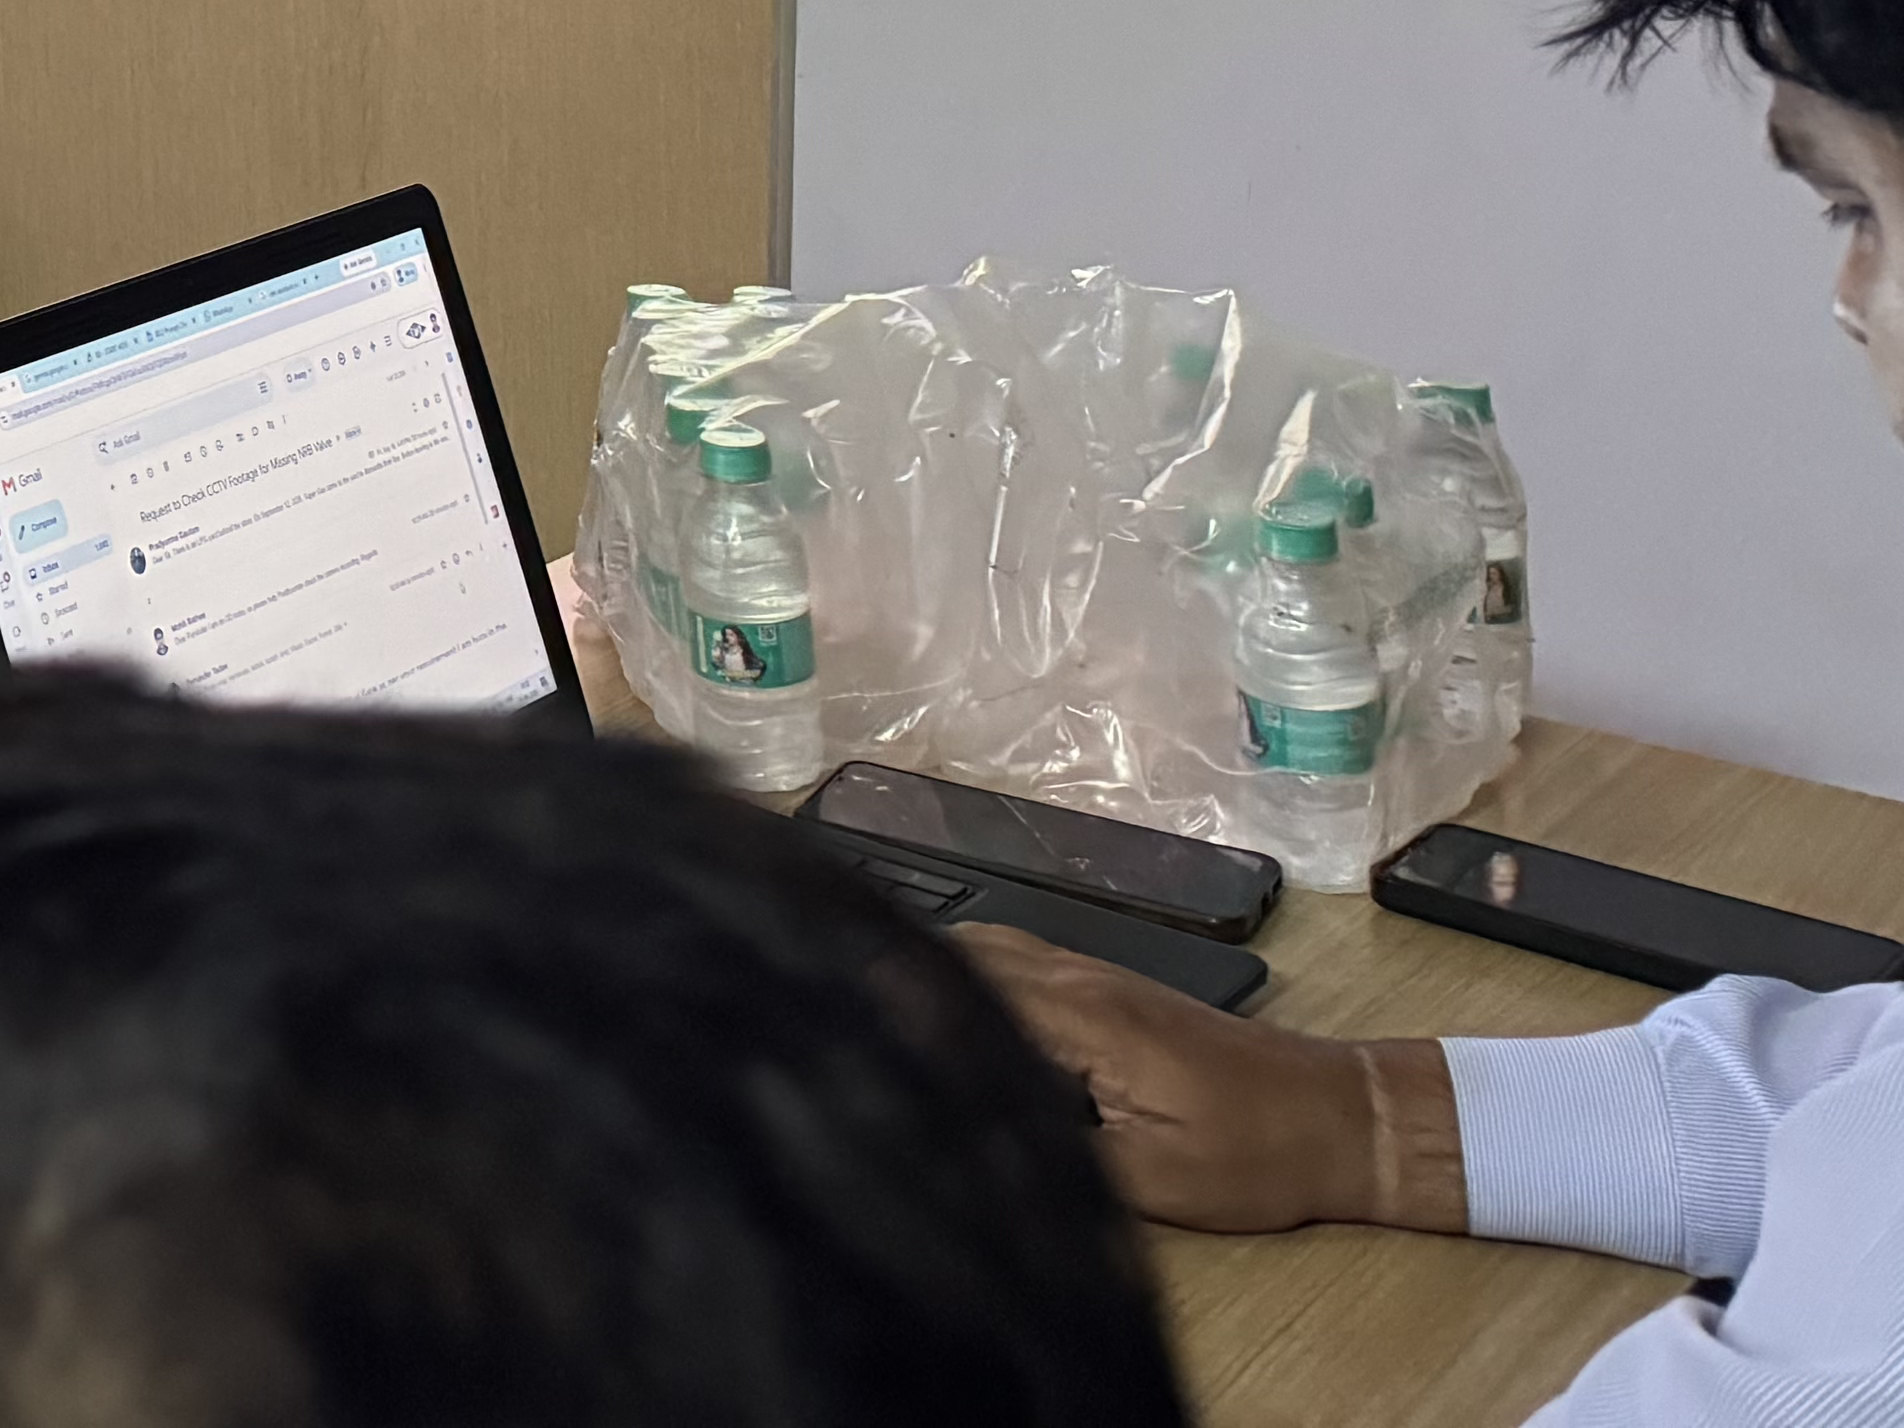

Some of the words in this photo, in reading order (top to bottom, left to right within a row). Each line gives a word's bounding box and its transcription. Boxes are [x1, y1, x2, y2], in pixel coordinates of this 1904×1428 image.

[18, 467, 43, 489] Gmail
[140, 503, 173, 525] Request
[182, 488, 206, 508] Check
[206, 479, 229, 500] CCTV
[228, 469, 260, 491] Footage
[259, 462, 269, 477] for
